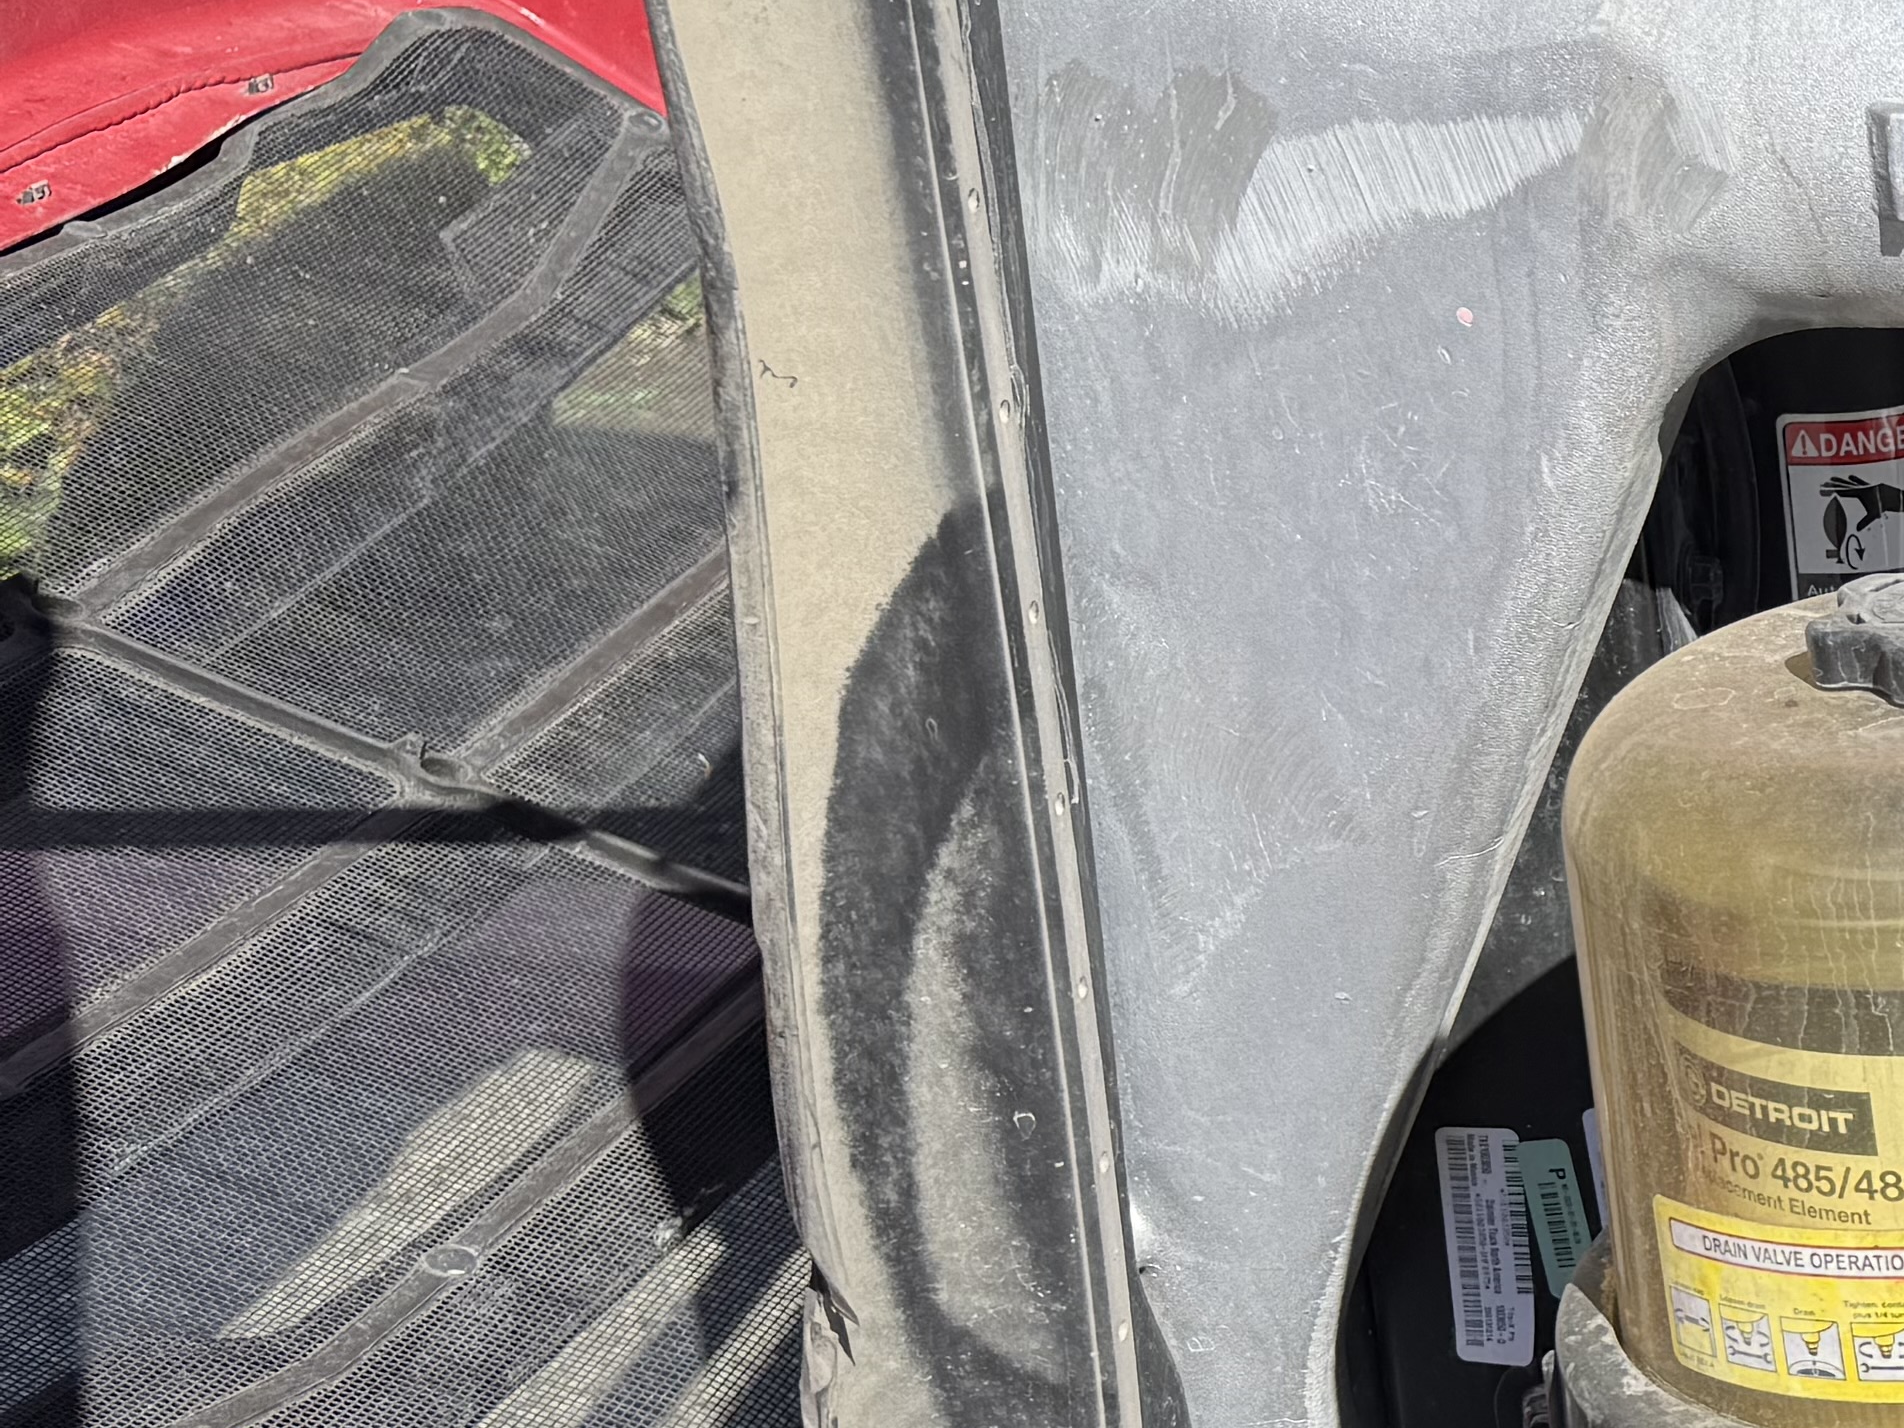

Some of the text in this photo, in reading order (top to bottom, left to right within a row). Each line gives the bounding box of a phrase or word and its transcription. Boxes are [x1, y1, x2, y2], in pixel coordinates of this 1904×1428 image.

[1711, 1082, 1857, 1134] DETROIT
[1549, 1167, 1567, 1180] P
[1789, 1196, 1873, 1226] Element
[1702, 1234, 1749, 1261] DRAIN
[1750, 1245, 1805, 1269] VALVE
